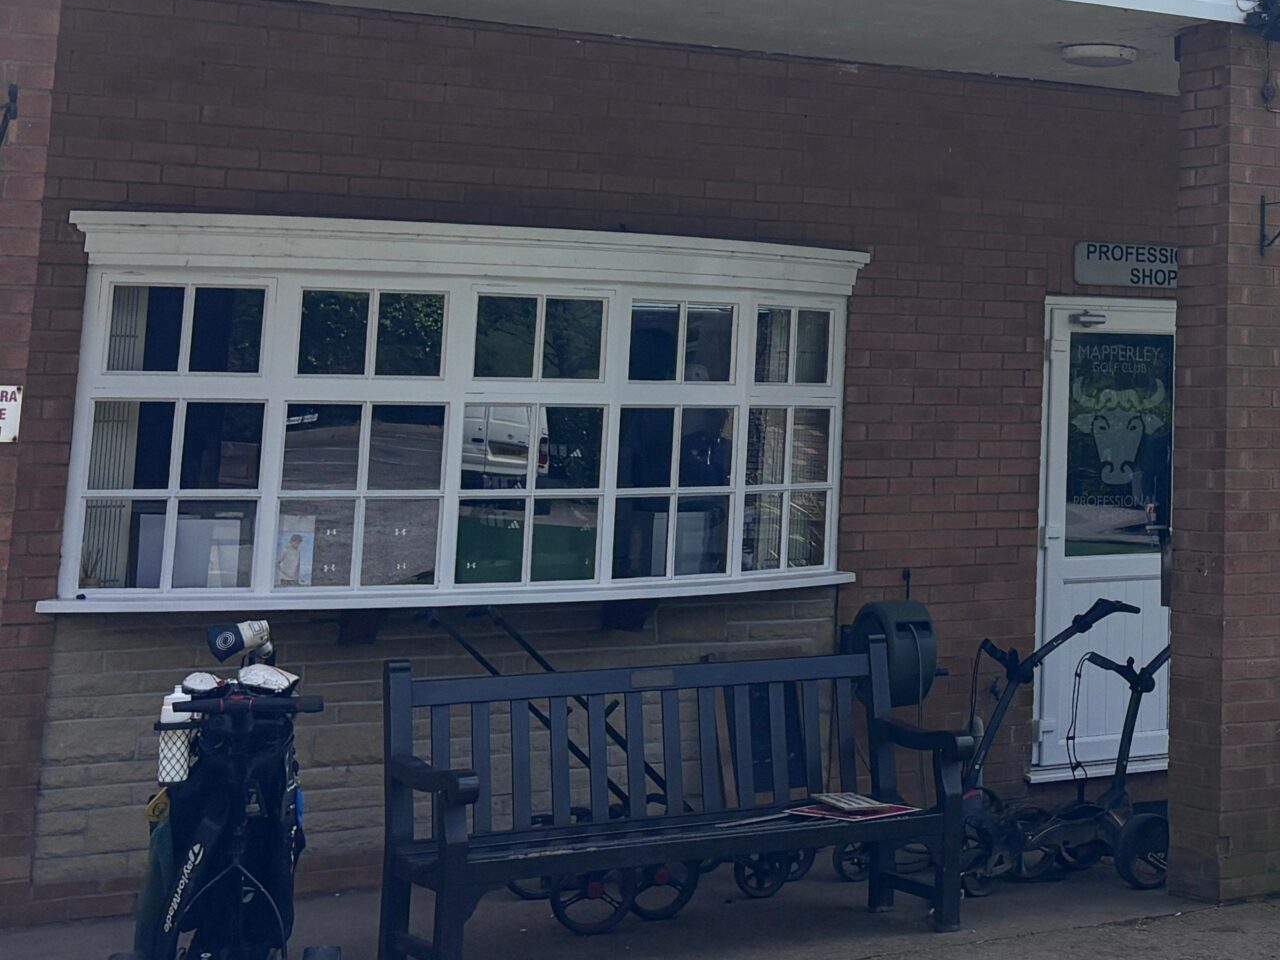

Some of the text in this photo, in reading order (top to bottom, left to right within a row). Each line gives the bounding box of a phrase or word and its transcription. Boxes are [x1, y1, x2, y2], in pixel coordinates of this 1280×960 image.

[1086, 243, 1178, 265] PROFESSI
[1129, 268, 1178, 286] SHOP
[1078, 345, 1161, 362] MAPPERLEY
[1121, 364, 1147, 373] CLUB
[163, 843, 204, 932] TaylorMade
